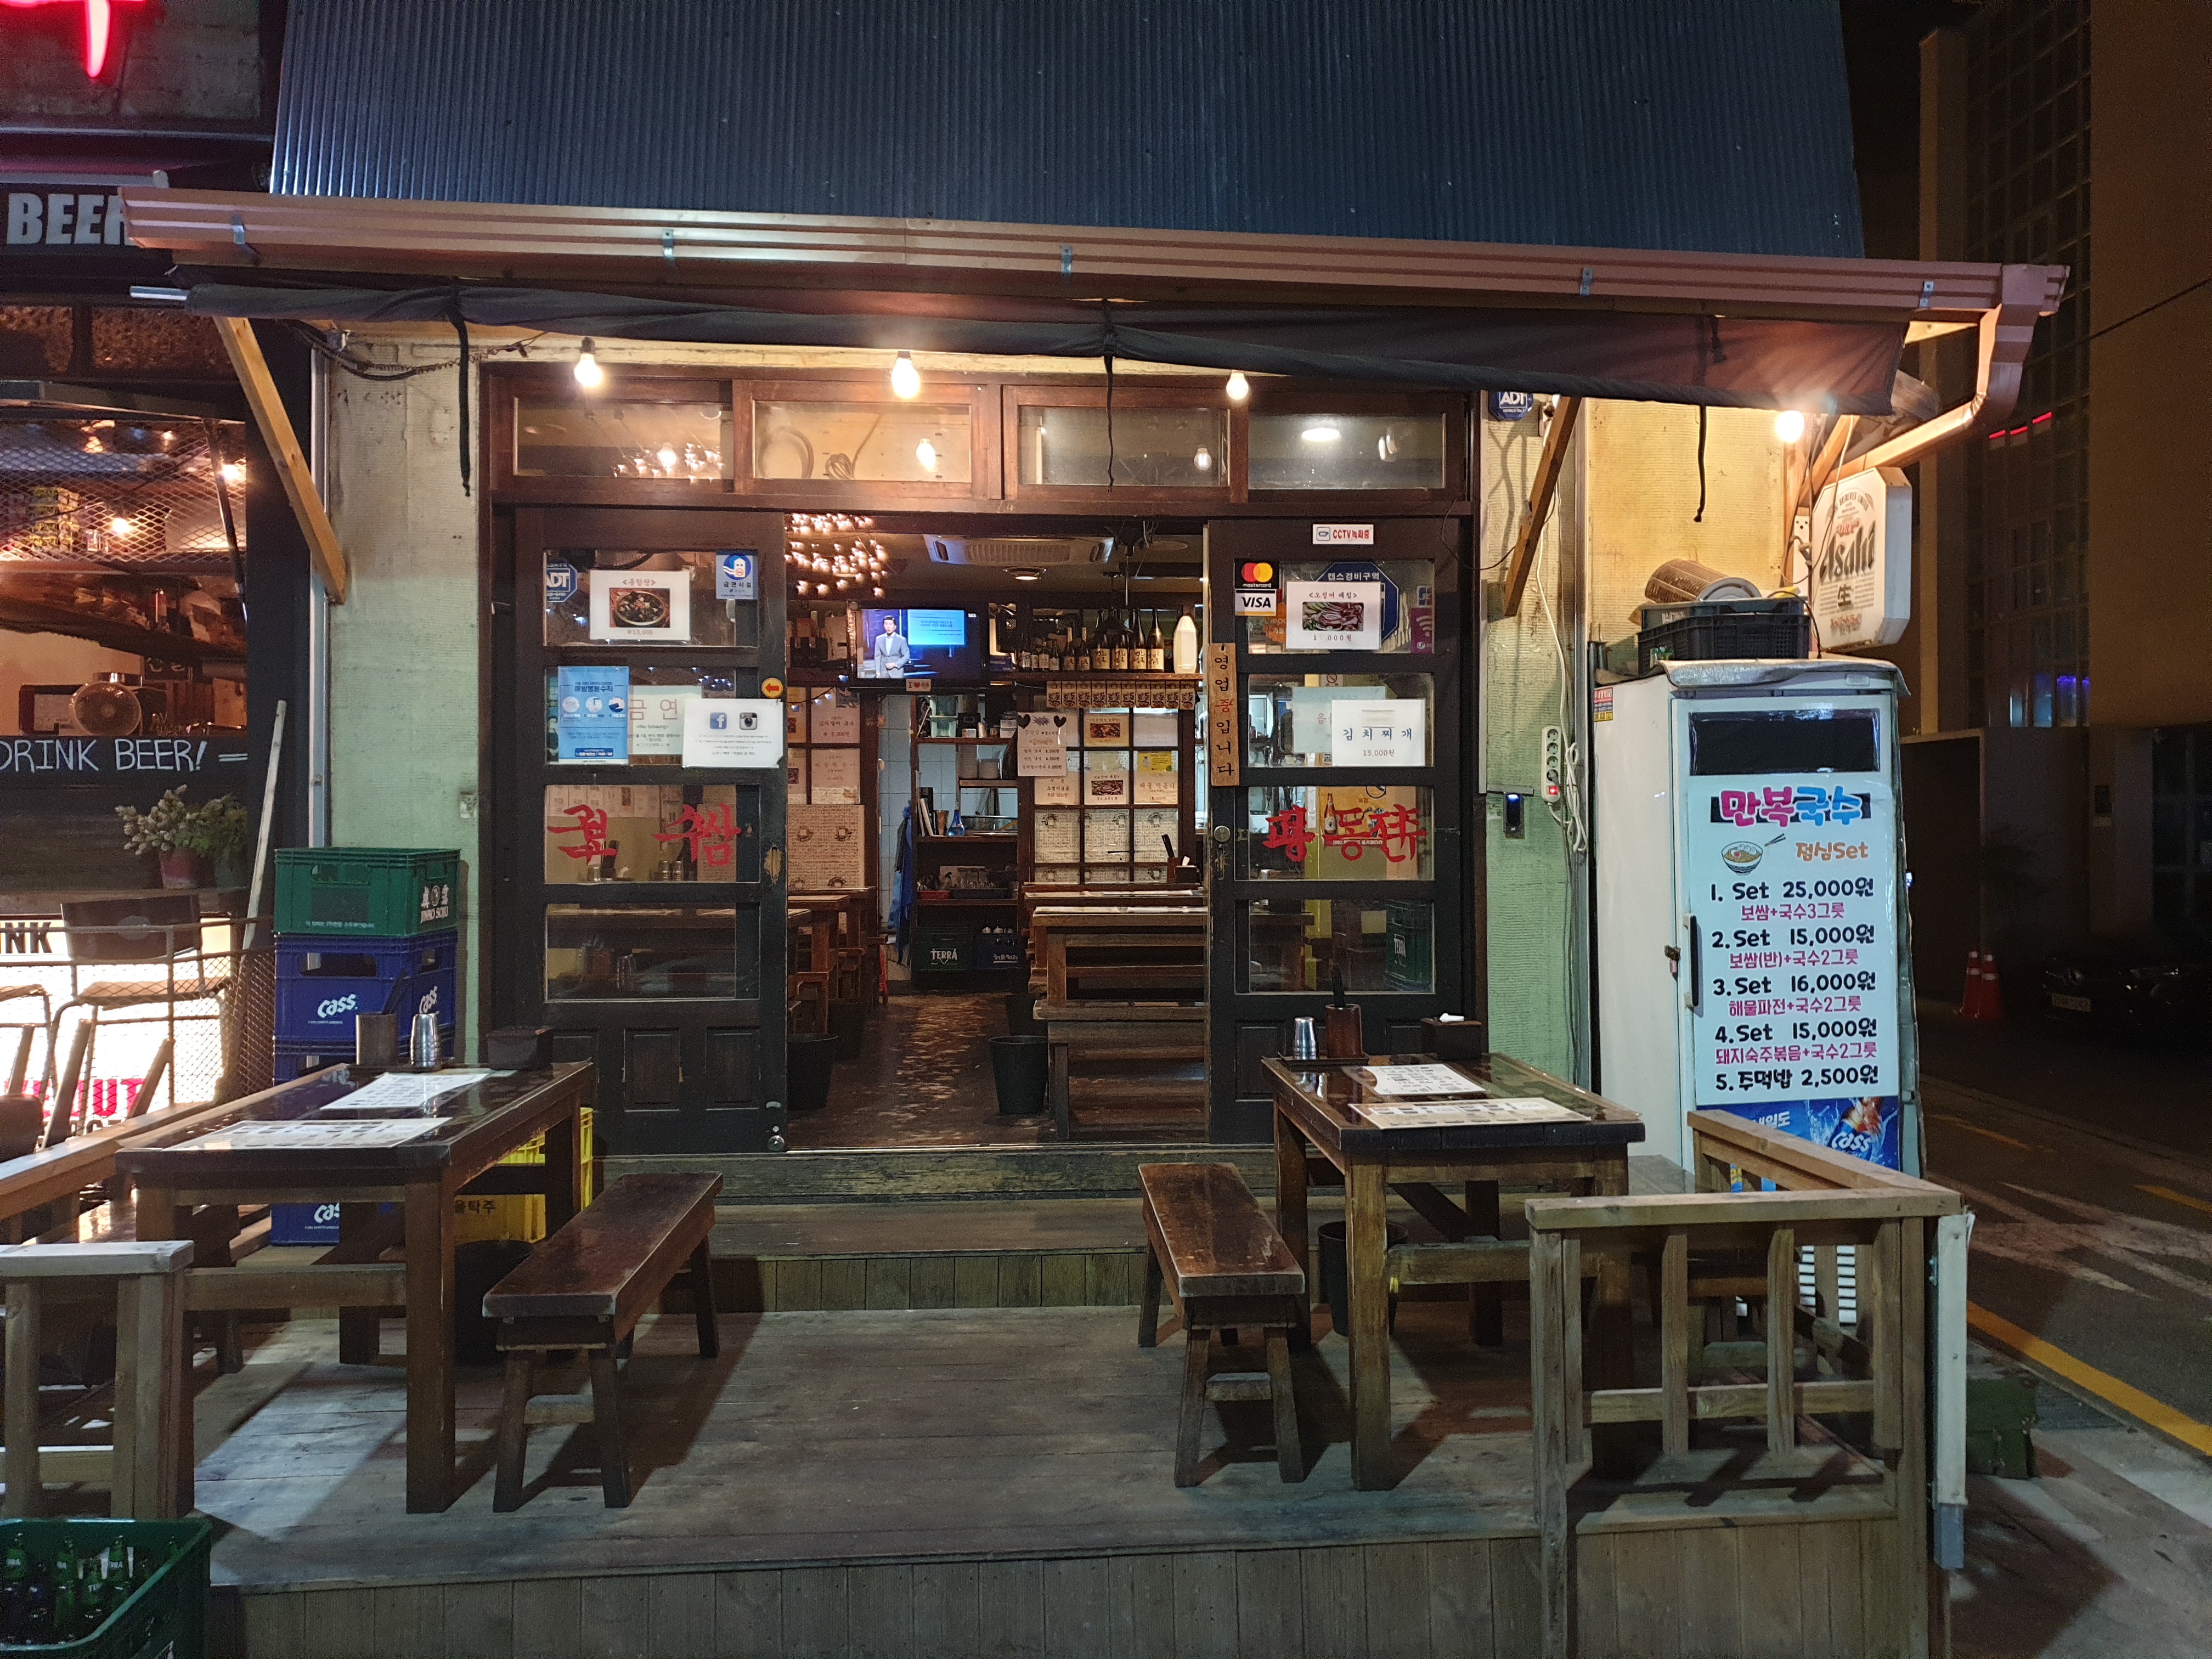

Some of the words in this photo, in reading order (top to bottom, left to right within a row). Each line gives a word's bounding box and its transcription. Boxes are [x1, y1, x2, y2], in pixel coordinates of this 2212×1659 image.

[1819, 521, 1876, 585] Asahi
[1242, 597, 1271, 608] VISA
[1214, 655, 1234, 778] 영업중입니다
[1343, 727, 1412, 741] 김치찌개
[115, 738, 208, 772] BEER!
[1720, 786, 1862, 827] 만복국수
[1782, 878, 1874, 900] 25,000원
[1741, 902, 1846, 922] 보쌈+국수3그릇
[4, 922, 52, 953] NK
[1790, 924, 1875, 947] 15,000원
[930, 948, 958, 961] TERRA
[1729, 949, 1859, 969] 보쌈(반)+국수2그릇
[1791, 971, 1876, 994] 16,000원
[1729, 995, 1861, 1017] 해물파전+국수2그릇
[1792, 1018, 1877, 1040] 15,000원
[1716, 1042, 1878, 1065] 돼지숙주볶음+국수2그릇
[1801, 1064, 1879, 1088] 2,500원
[314, 1203, 340, 1223] Ca
